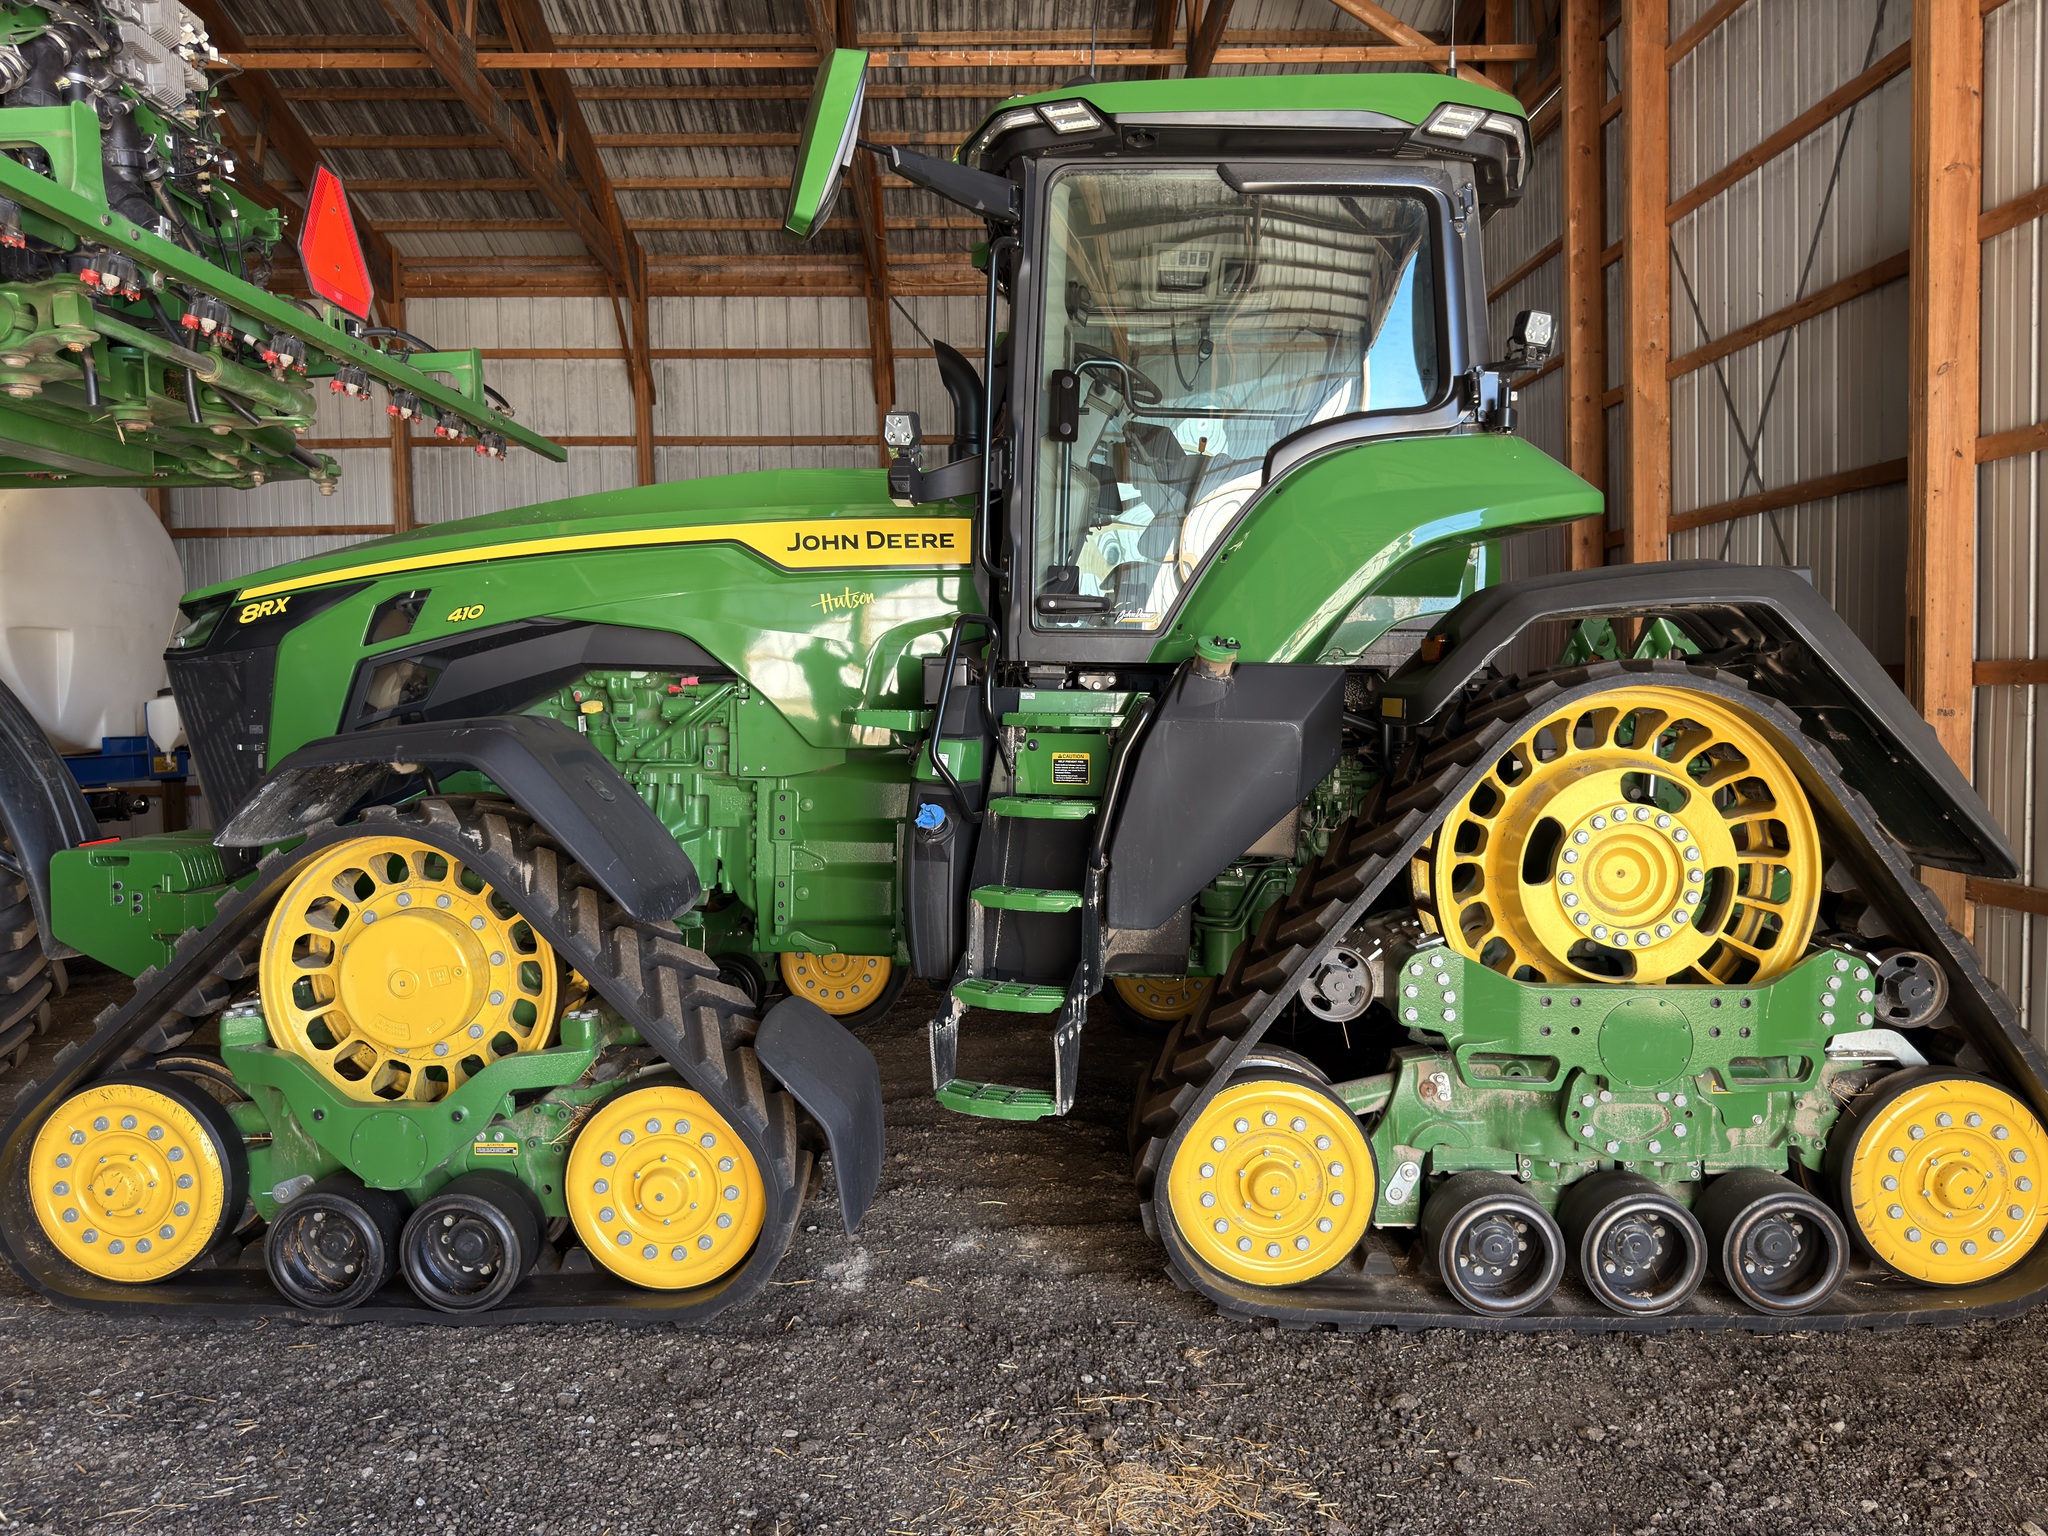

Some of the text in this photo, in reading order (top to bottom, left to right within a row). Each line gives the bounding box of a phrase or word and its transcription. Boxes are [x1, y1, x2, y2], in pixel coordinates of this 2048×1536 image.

[787, 530, 955, 552] JOHN DEERE
[238, 596, 292, 625] 8RX
[445, 603, 486, 623] 410
[810, 586, 880, 615] Hutson
